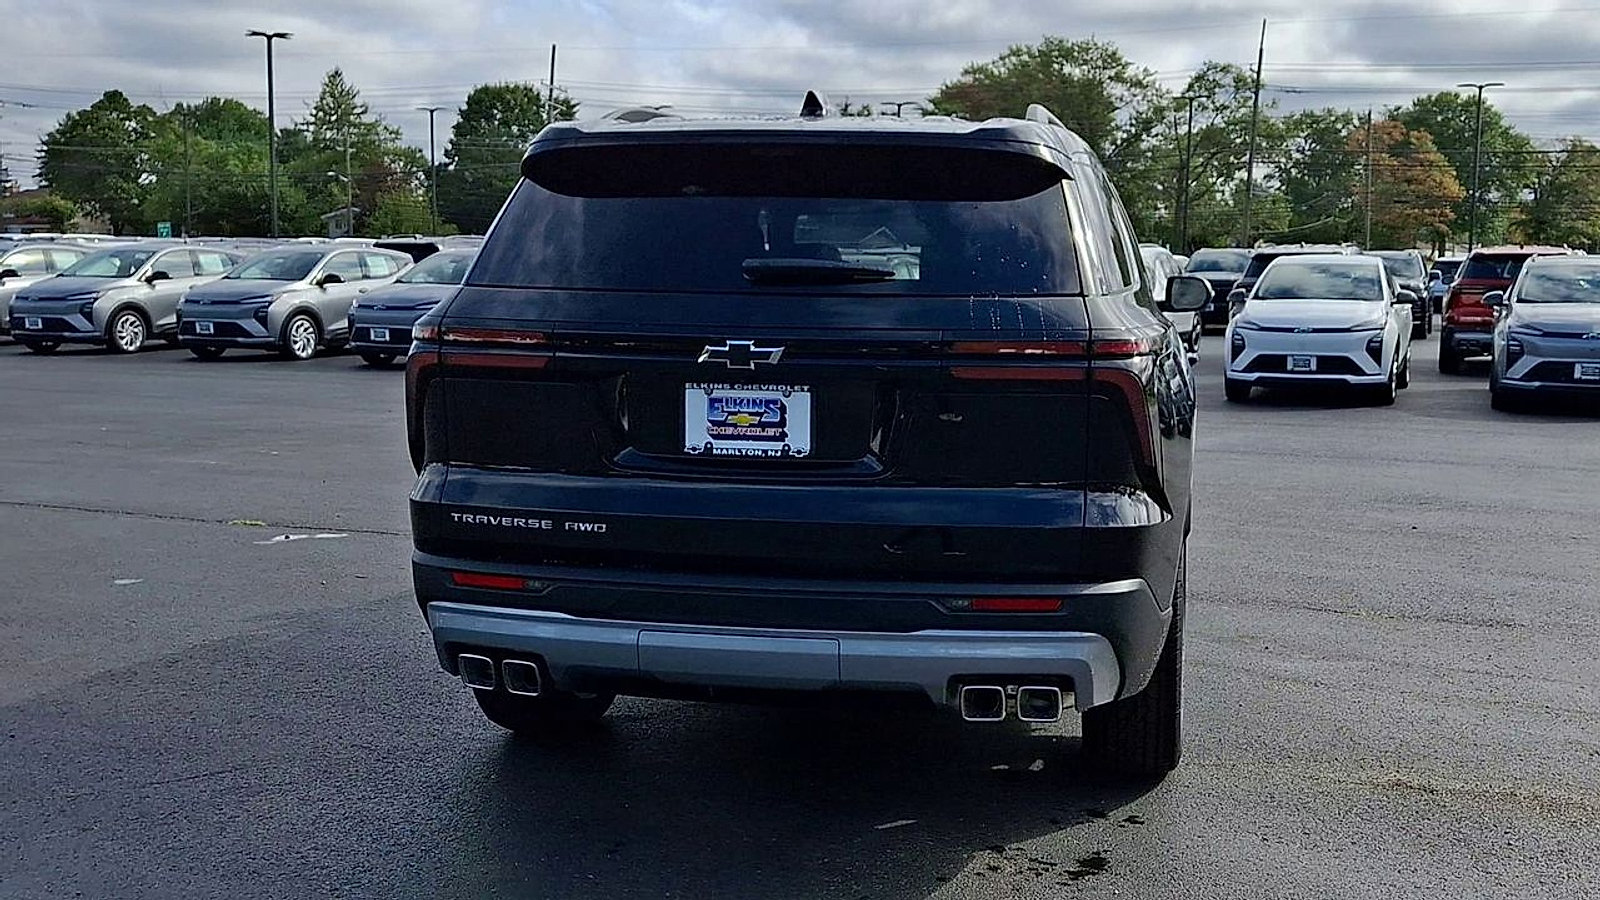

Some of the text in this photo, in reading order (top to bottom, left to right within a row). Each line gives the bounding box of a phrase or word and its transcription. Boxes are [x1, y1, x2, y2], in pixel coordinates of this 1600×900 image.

[685, 382, 810, 392] ELKINS CHEVROLET
[707, 397, 782, 422] ELKINS
[708, 427, 782, 436] CHEVROLET
[713, 448, 766, 457] MARLTON,
[451, 513, 607, 533] TRAVERSE AWD
